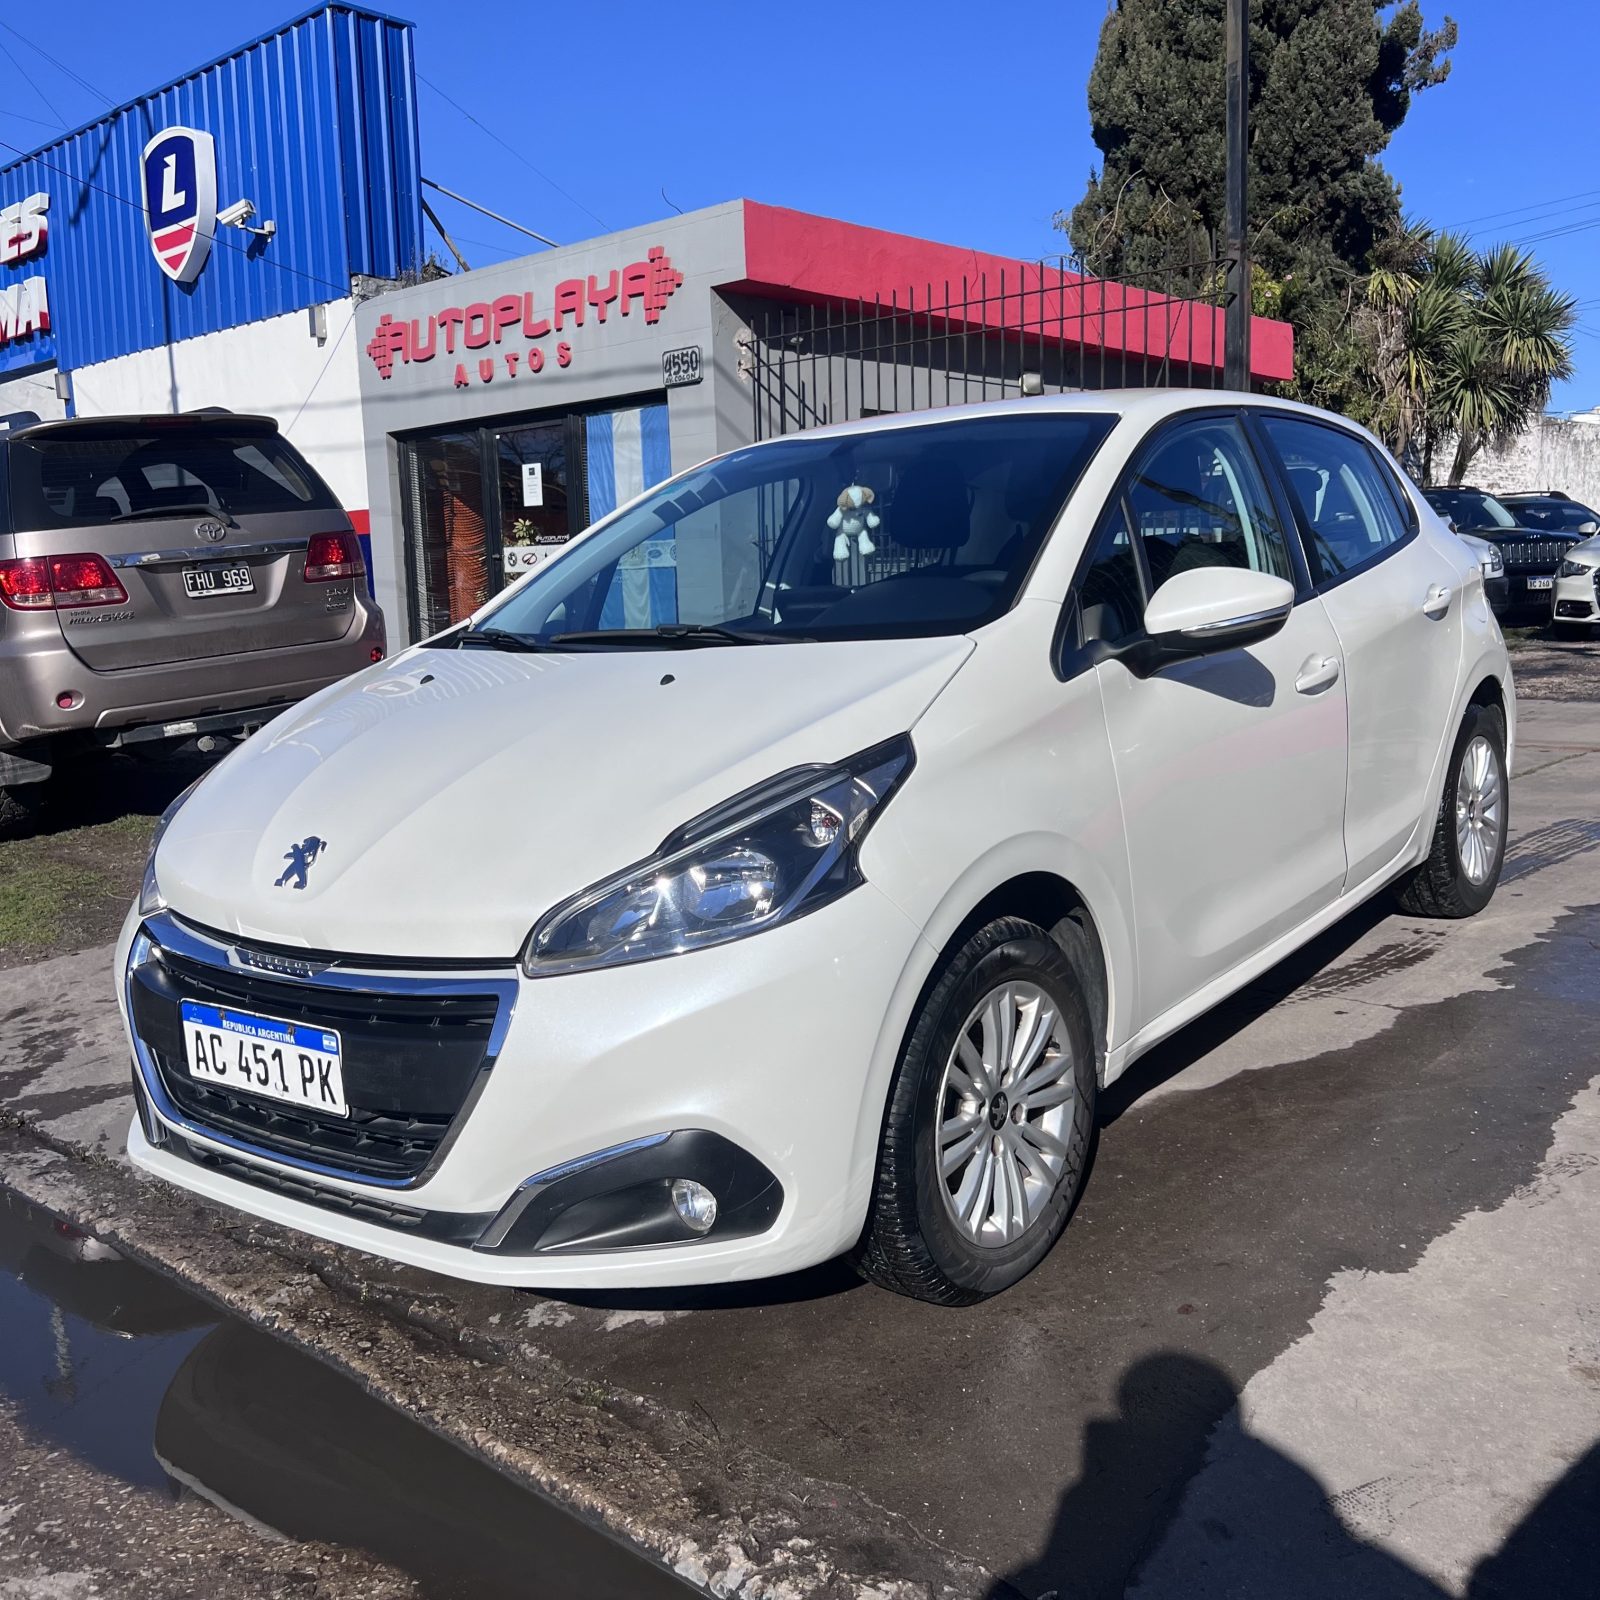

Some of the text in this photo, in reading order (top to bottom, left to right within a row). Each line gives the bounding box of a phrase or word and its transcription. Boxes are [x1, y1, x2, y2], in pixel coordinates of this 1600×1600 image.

[386, 261, 654, 364] AUTOPLAYA
[454, 342, 573, 388] AUTOS
[664, 350, 698, 376] 4550
[186, 569, 250, 590] FHU 969
[222, 1020, 256, 1036] REPUBLICA
[257, 1027, 296, 1044] ARGENTINA
[195, 1030, 337, 1105] AC 451 PK
